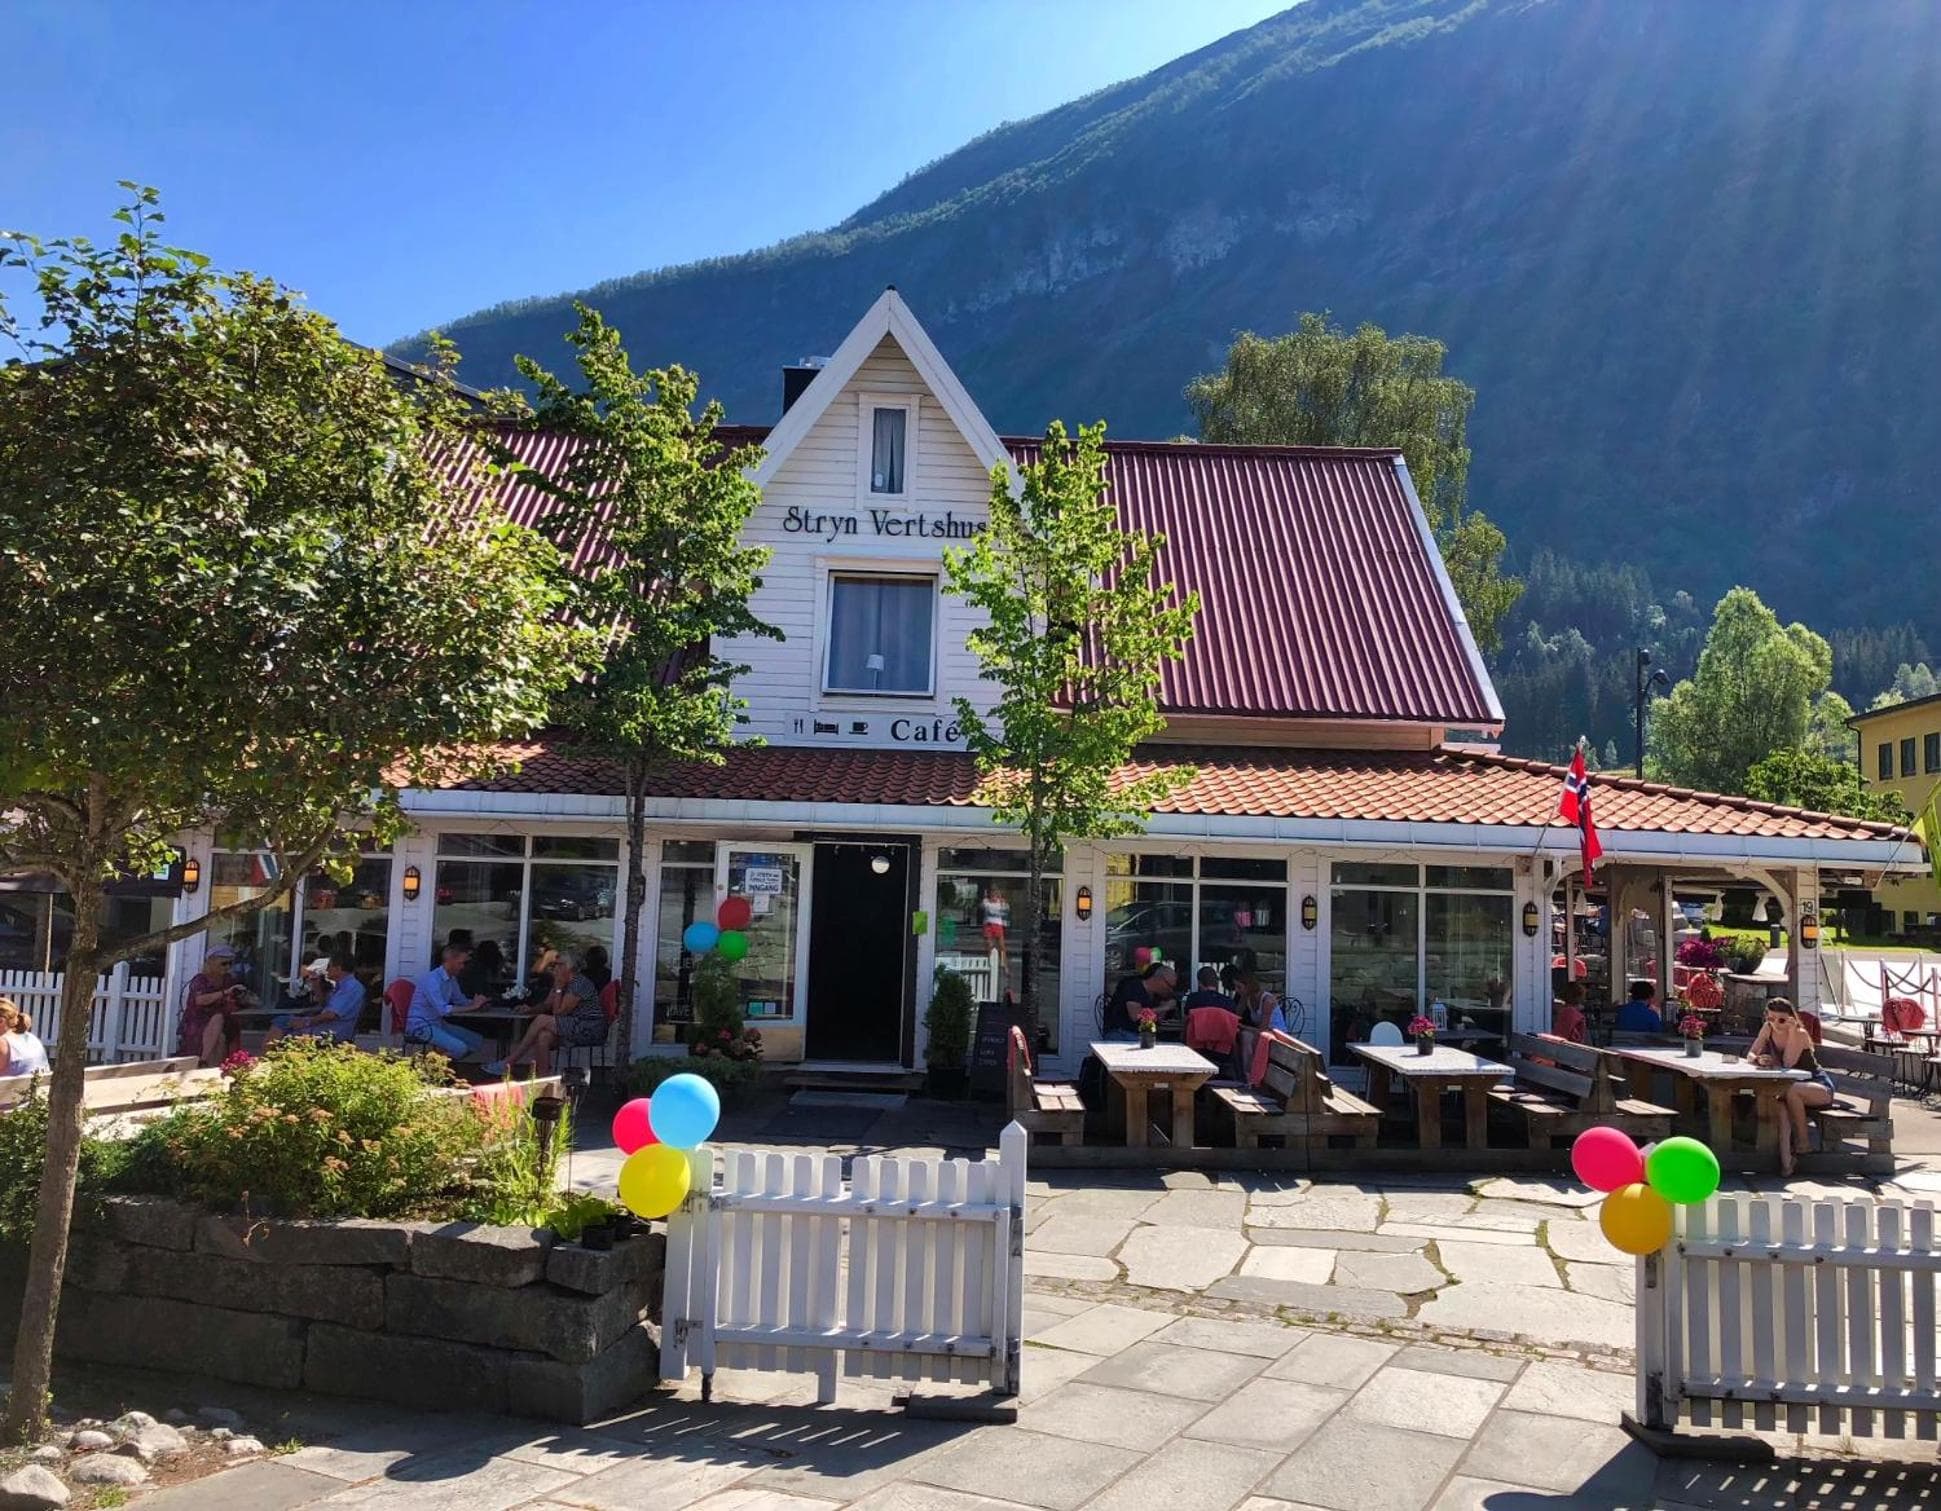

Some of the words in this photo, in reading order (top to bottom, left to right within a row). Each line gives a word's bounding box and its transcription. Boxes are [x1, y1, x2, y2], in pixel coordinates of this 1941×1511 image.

[783, 505, 857, 543] Stryn
[869, 509, 987, 539] Vertshus
[890, 719, 961, 742] Café
[1802, 901, 1814, 913] 19
